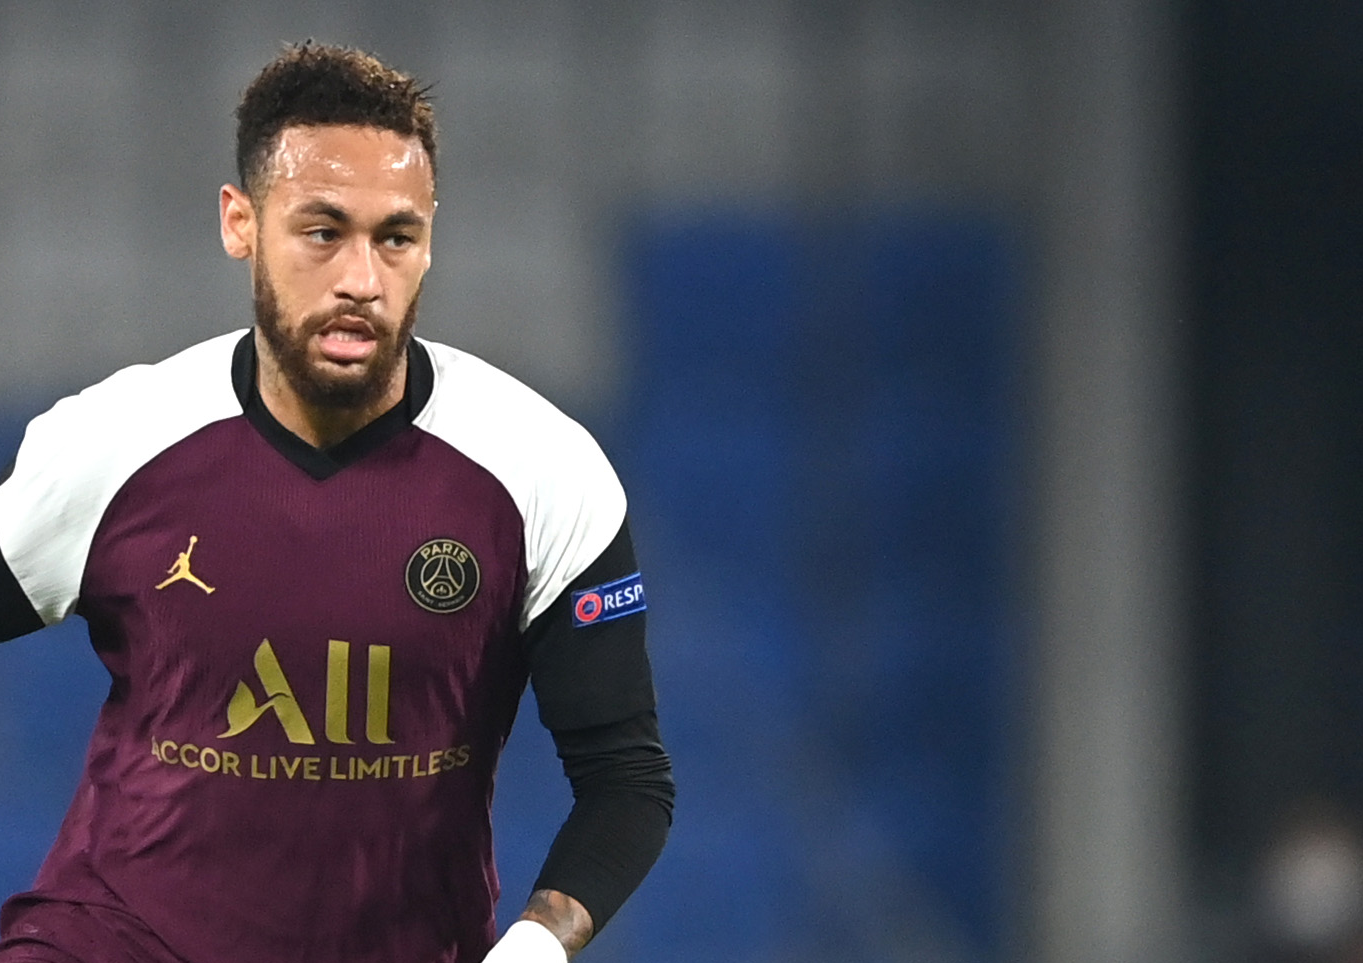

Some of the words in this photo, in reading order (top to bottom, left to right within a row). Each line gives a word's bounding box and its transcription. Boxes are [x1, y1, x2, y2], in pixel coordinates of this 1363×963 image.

[420, 543, 469, 563] PARIS
[251, 754, 321, 780] LIVE
[330, 745, 470, 780] LIMITLESS
